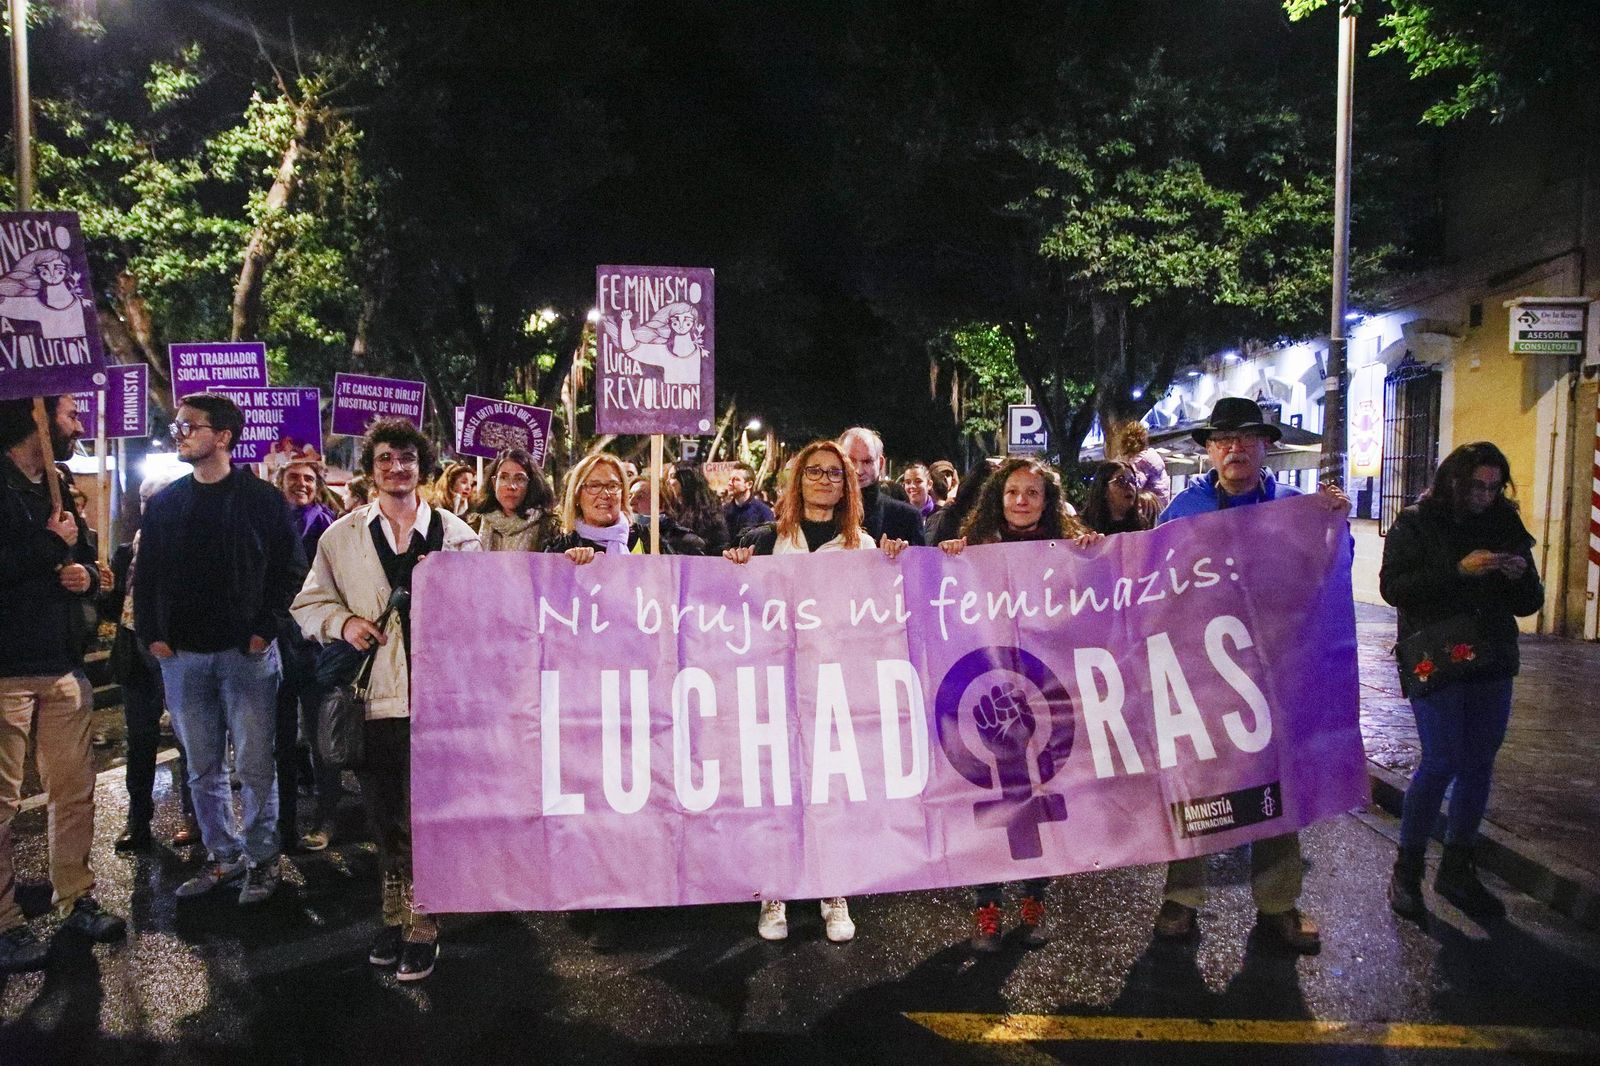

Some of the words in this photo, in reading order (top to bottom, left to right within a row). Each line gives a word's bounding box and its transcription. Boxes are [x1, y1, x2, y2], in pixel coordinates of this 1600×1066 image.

[0, 219, 71, 275] NISMO
[600, 274, 702, 324] FEMINISMO
[1527, 331, 1569, 339] ASESORÍA
[603, 333, 643, 376] LUCHA
[1519, 342, 1576, 352] CONSULTORÍA
[180, 353, 198, 366] SOY
[199, 352, 257, 366] TRABAJADOR
[177, 368, 210, 381] SOCIAL
[211, 366, 260, 380] FEMINISTA
[123, 370, 139, 431] FEMINISTA
[254, 392, 269, 407] ME
[337, 382, 351, 395] ¿TE
[352, 384, 382, 397] CANSAS
[383, 387, 394, 399] DE
[395, 387, 420, 402] OÍRLO?
[604, 378, 701, 410] REVOLUCIÓN
[338, 397, 377, 411] NOSOTRAS
[378, 401, 389, 413] DE
[390, 402, 419, 416] VIVIRLO
[494, 402, 504, 414] DE
[504, 403, 518, 416] LAS
[516, 407, 531, 423] QUE
[245, 409, 285, 424] PORQUE
[469, 416, 481, 427] EL
[526, 417, 538, 430] YA
[463, 423, 477, 447] SOMOS
[532, 427, 544, 439] NO
[1011, 408, 1043, 444] P
[682, 442, 699, 461] P
[538, 584, 610, 635] Ni
[636, 583, 822, 655] brujas
[850, 574, 911, 626] ni
[930, 548, 1240, 641] feminazis:
[1184, 796, 1233, 821] AMNISTÍA
[1186, 814, 1235, 832] INTERNACIONAL
